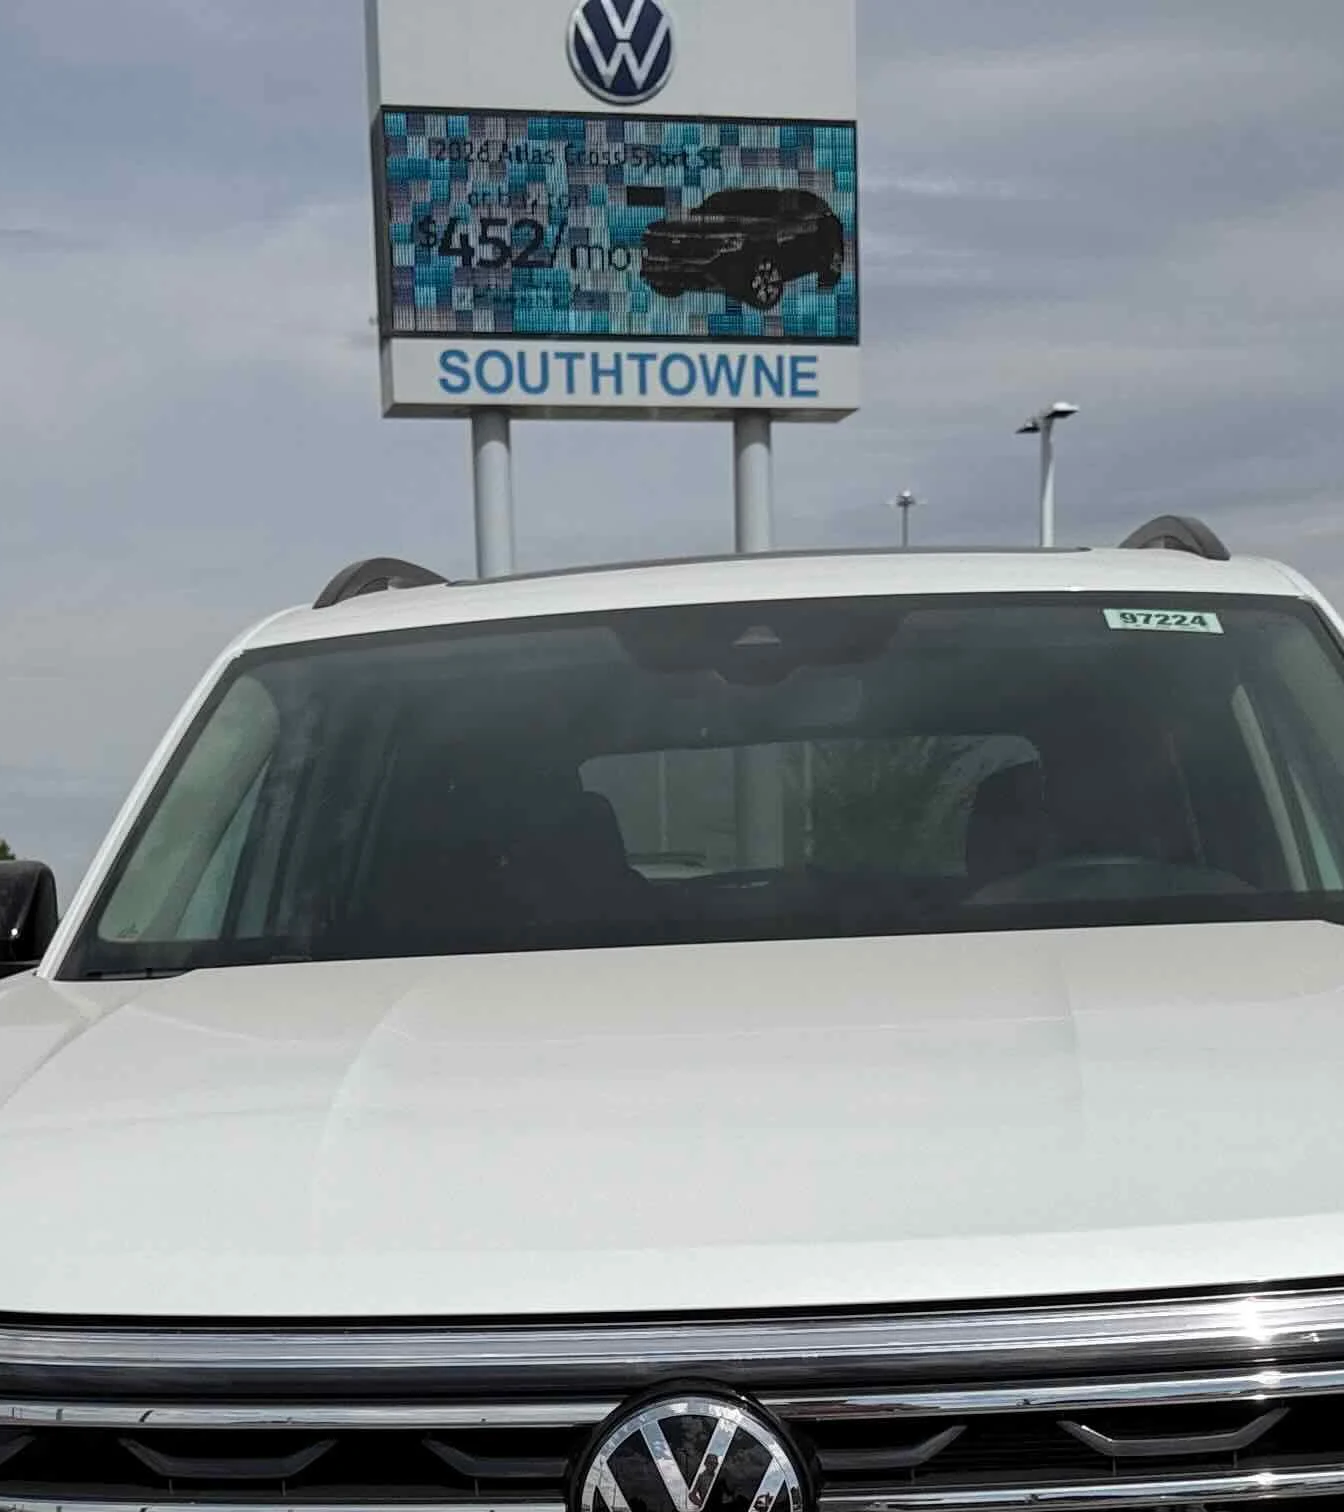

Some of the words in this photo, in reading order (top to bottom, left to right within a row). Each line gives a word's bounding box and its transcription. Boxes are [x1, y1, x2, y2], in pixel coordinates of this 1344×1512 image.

[571, 0, 669, 89] VW
[497, 142, 555, 165] Atlas
[630, 146, 690, 173] Sport
[439, 350, 819, 399] SOUTHTOWNE
[1119, 612, 1208, 626] 97224
